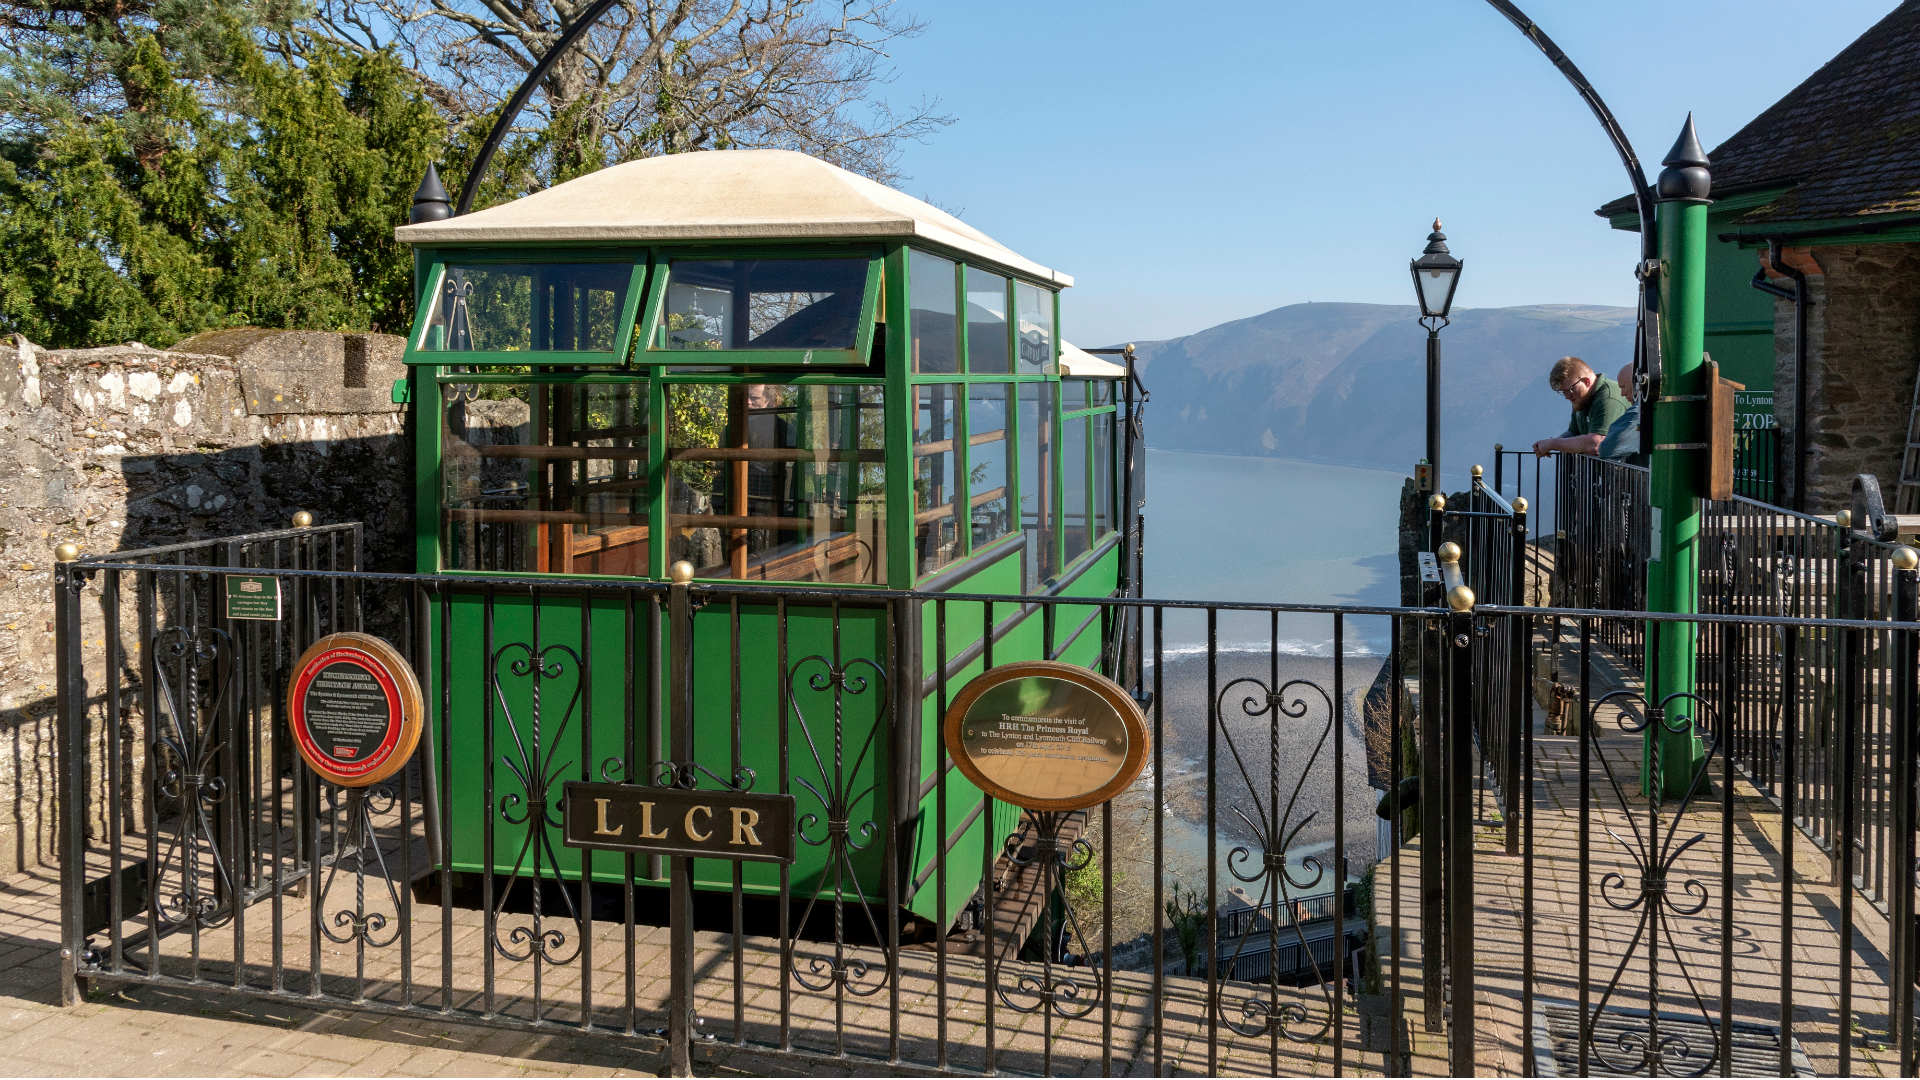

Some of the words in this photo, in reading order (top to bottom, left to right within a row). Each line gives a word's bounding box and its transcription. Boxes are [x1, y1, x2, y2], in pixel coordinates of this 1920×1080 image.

[1735, 395, 1744, 404] To
[1746, 395, 1773, 407] Lynton
[1743, 413, 1775, 430] TOP
[1064, 716, 1077, 725] visit
[999, 722, 1019, 730] HRH
[1036, 725, 1066, 734] Princess
[1067, 727, 1088, 736] Royal
[1001, 731, 1021, 741] Lynton
